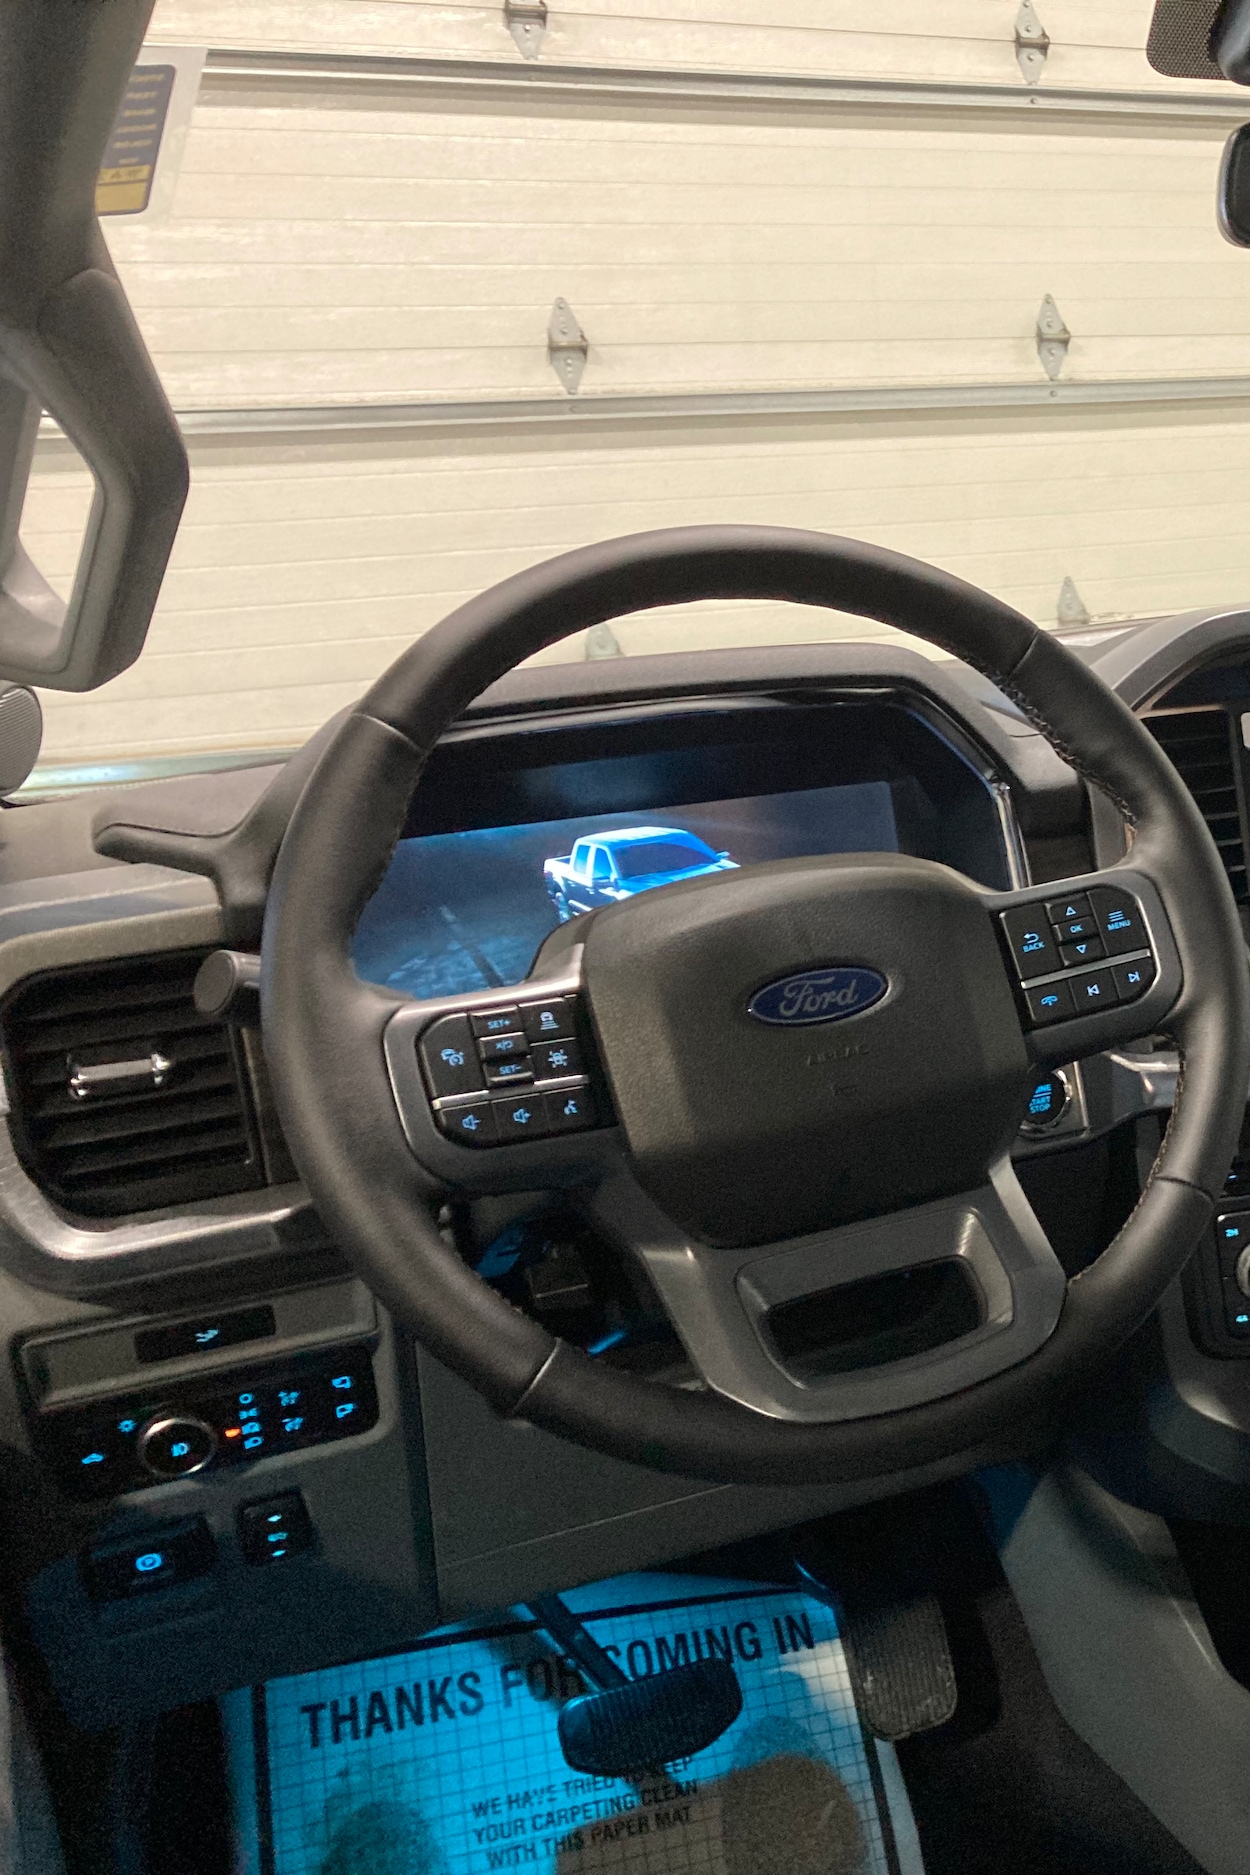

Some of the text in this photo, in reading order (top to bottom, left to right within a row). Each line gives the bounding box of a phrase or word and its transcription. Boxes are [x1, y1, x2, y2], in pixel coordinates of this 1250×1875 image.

[1069, 924, 1083, 934] OK
[1107, 919, 1131, 931] MENU
[1022, 941, 1045, 953] BACK
[779, 976, 859, 1017] Ford
[487, 1019, 511, 1030] SET+
[1029, 1104, 1051, 1114] STOP
[301, 1671, 485, 1749] THANKS
[772, 1612, 816, 1655] IN
[472, 1797, 503, 1818] WE
[507, 1785, 559, 1808] HAVE
[561, 1775, 616, 1799] TRIED
[473, 1778, 698, 1845] YOUR CARPETING CLEAN
[487, 1806, 692, 1869] WITH THIS PAPER MAT
